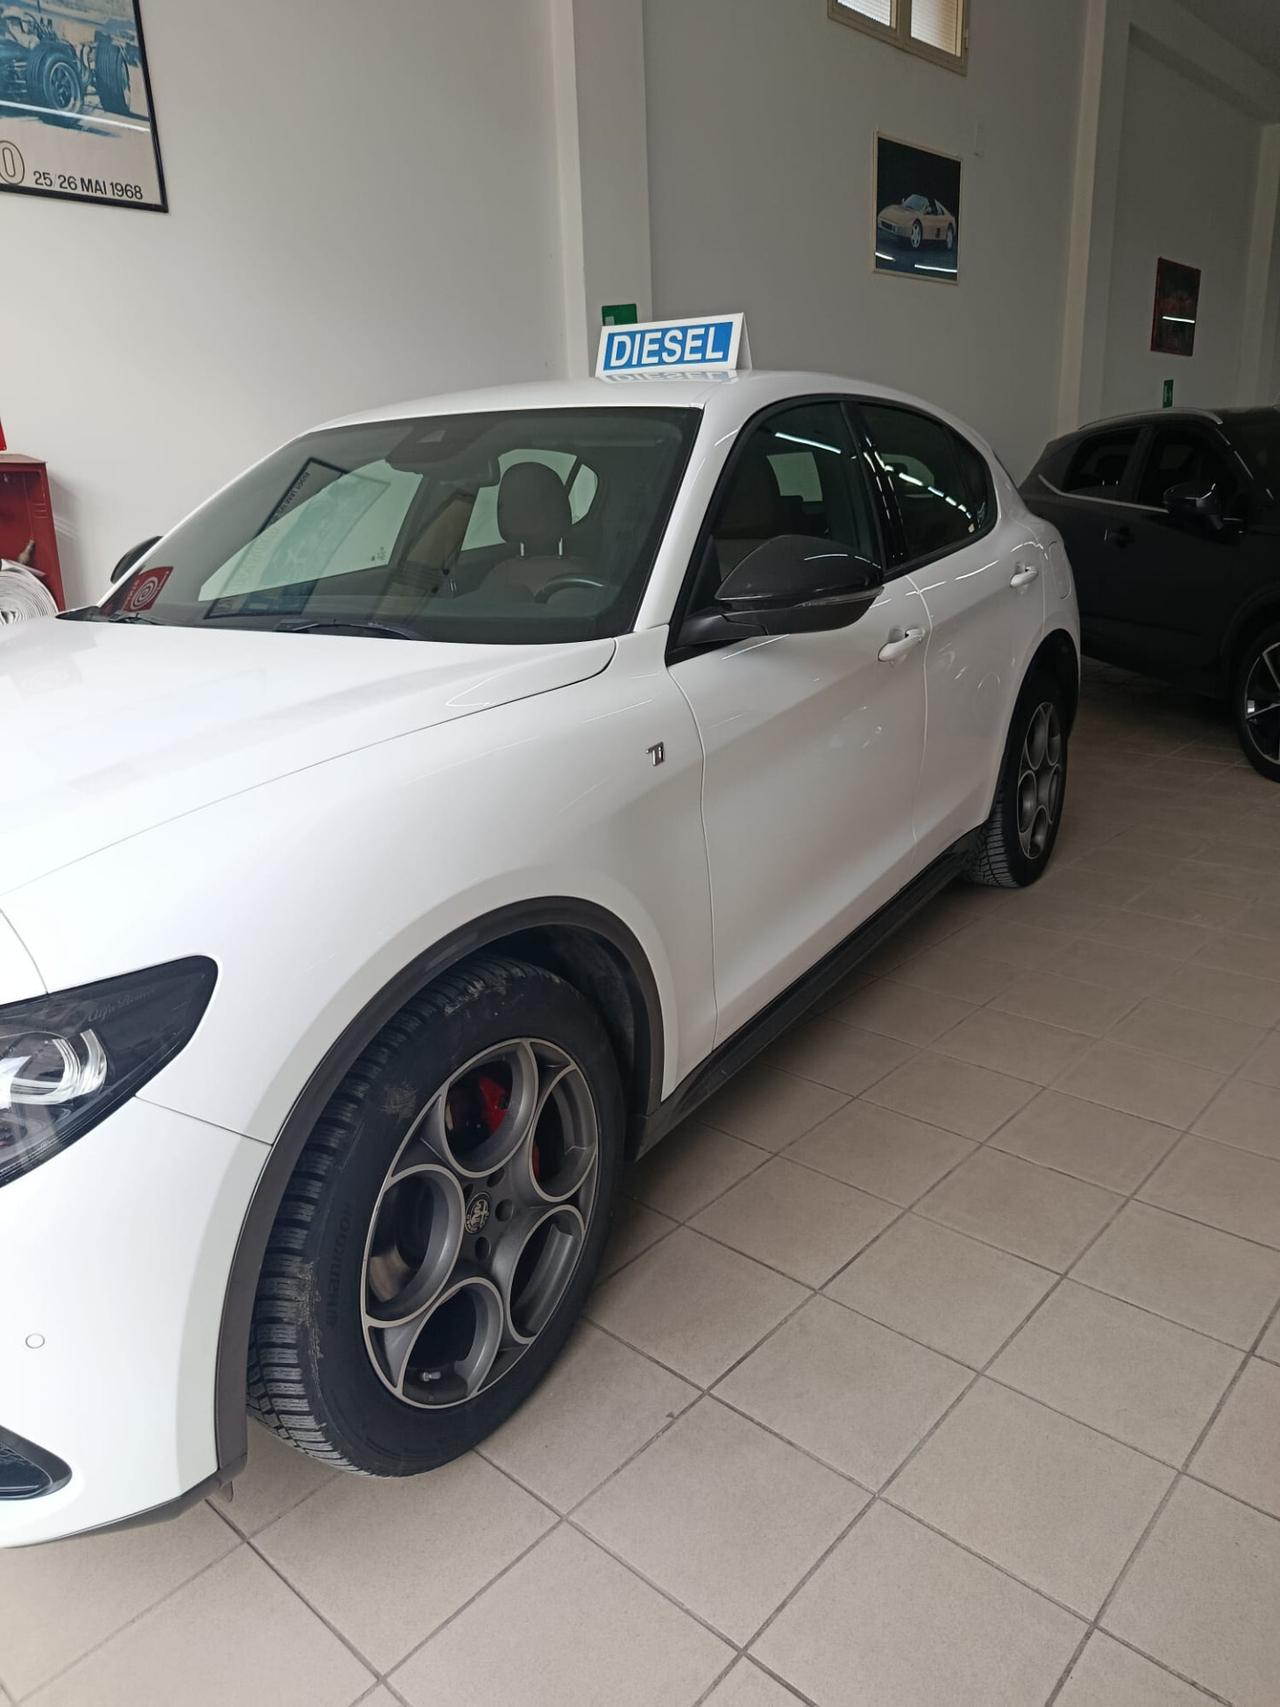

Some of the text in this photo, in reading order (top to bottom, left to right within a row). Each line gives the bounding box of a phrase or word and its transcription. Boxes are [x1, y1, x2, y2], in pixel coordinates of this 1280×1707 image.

[80, 177, 107, 195] MAI
[110, 181, 143, 200] 1968
[609, 326, 724, 368] DIESEL
